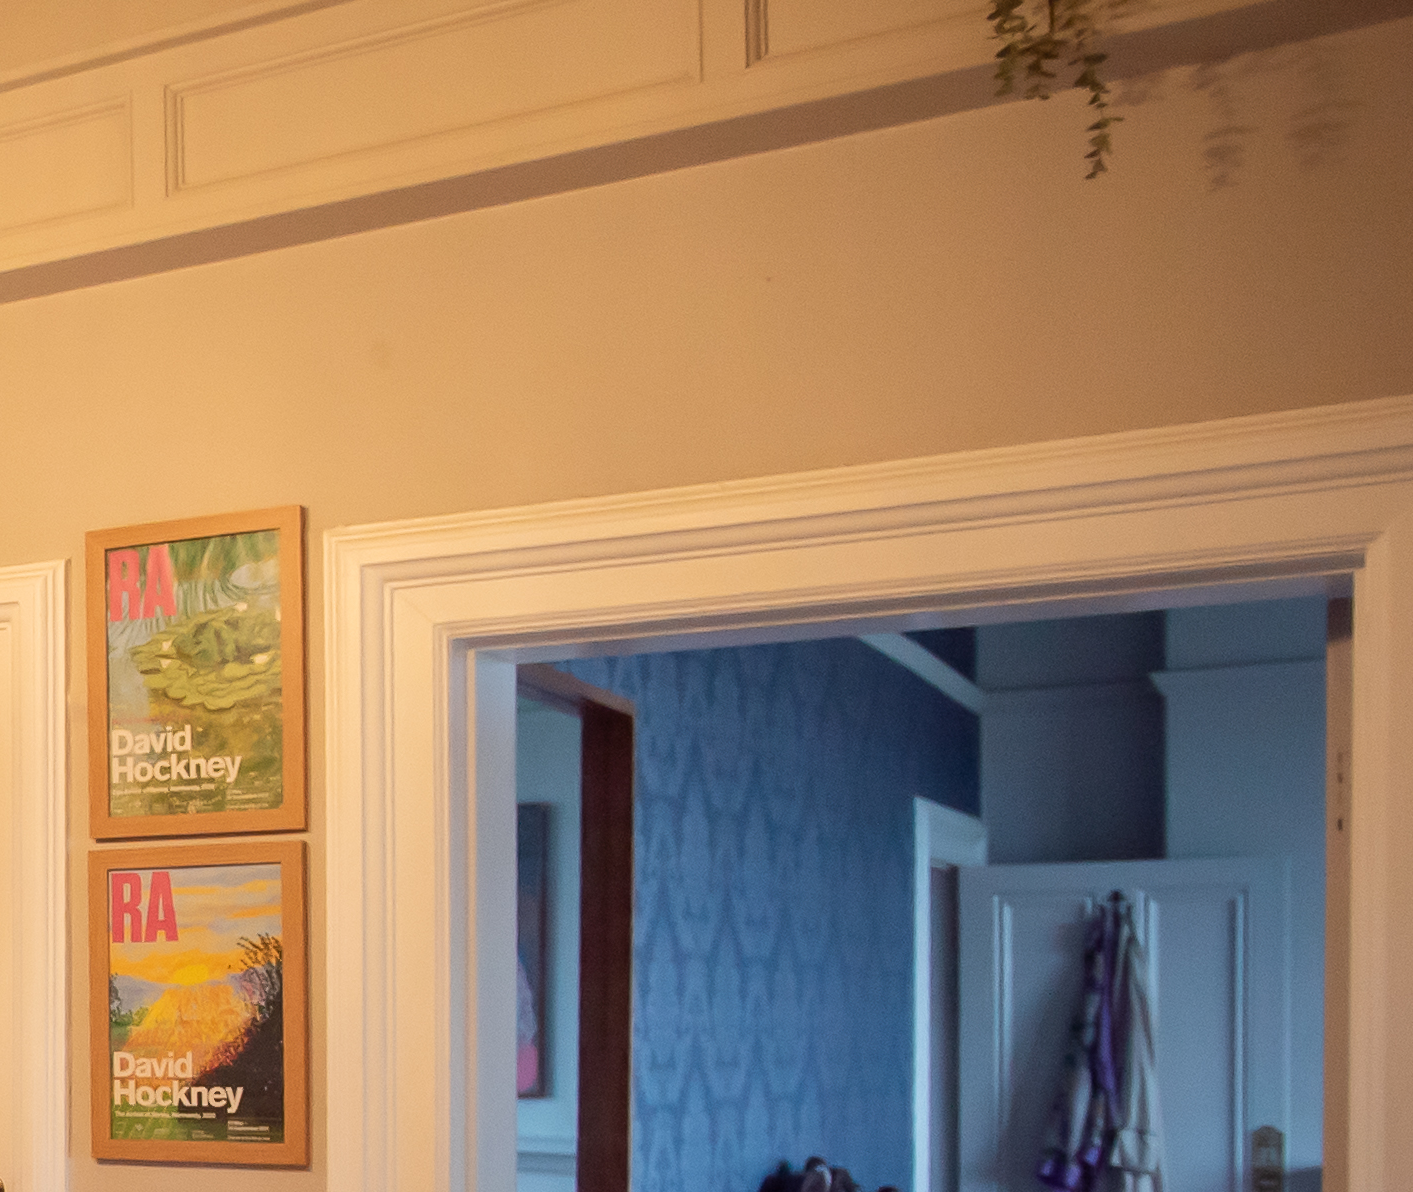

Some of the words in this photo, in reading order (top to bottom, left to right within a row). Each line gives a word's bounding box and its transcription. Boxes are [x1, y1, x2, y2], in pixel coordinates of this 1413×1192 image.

[108, 543, 177, 622] RA
[111, 724, 193, 756] David
[112, 754, 242, 783] Hockney
[111, 871, 179, 943] RA
[112, 1051, 193, 1078] David
[113, 1079, 244, 1113] Hockney
